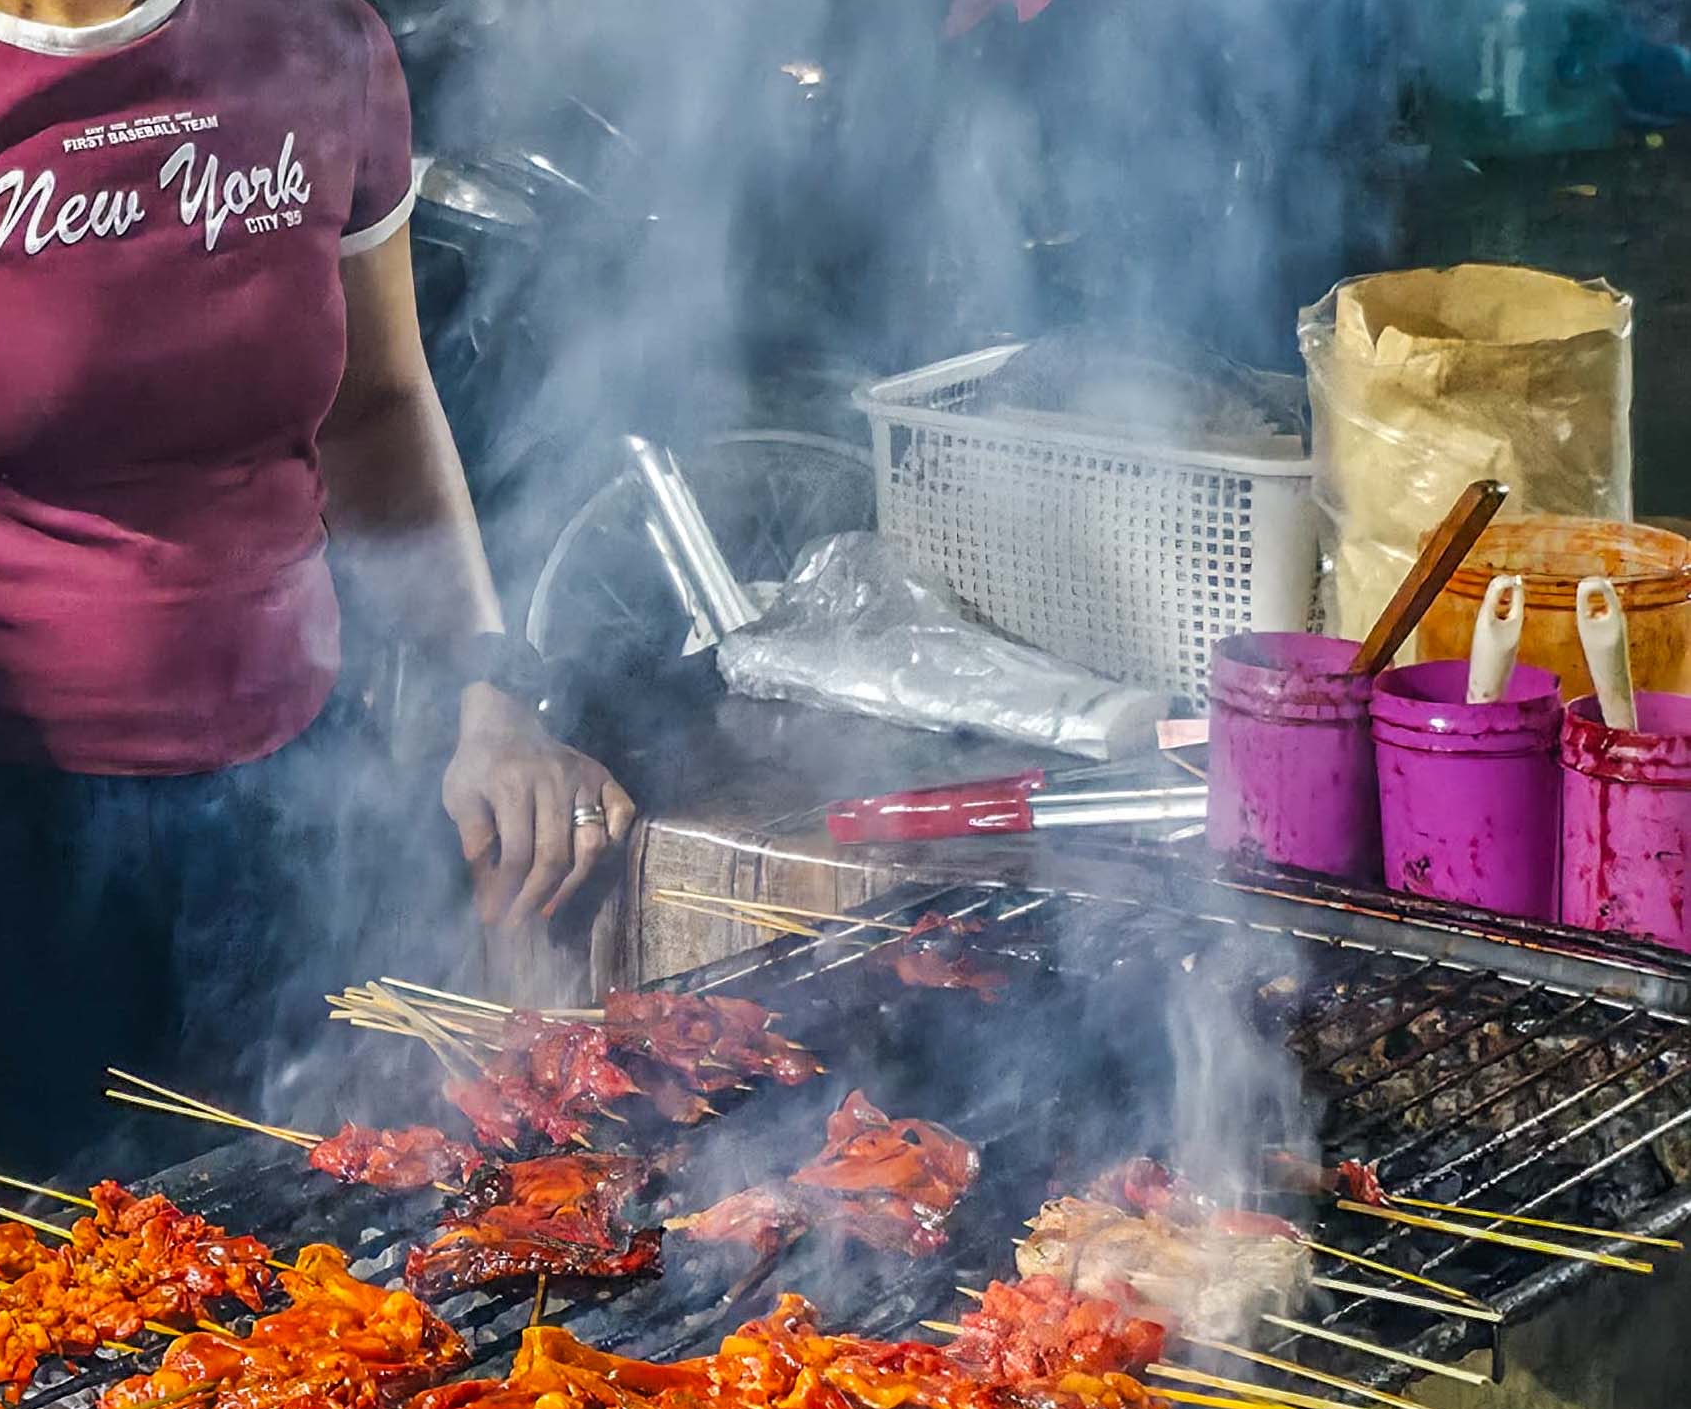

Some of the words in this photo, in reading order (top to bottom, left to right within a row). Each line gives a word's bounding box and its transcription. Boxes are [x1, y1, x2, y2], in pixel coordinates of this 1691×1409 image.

[63, 135, 104, 153] FIRST
[107, 122, 181, 145] BASEBALL
[181, 115, 219, 132] TEAM
[160, 131, 311, 252] York
[245, 213, 279, 233] CITY
